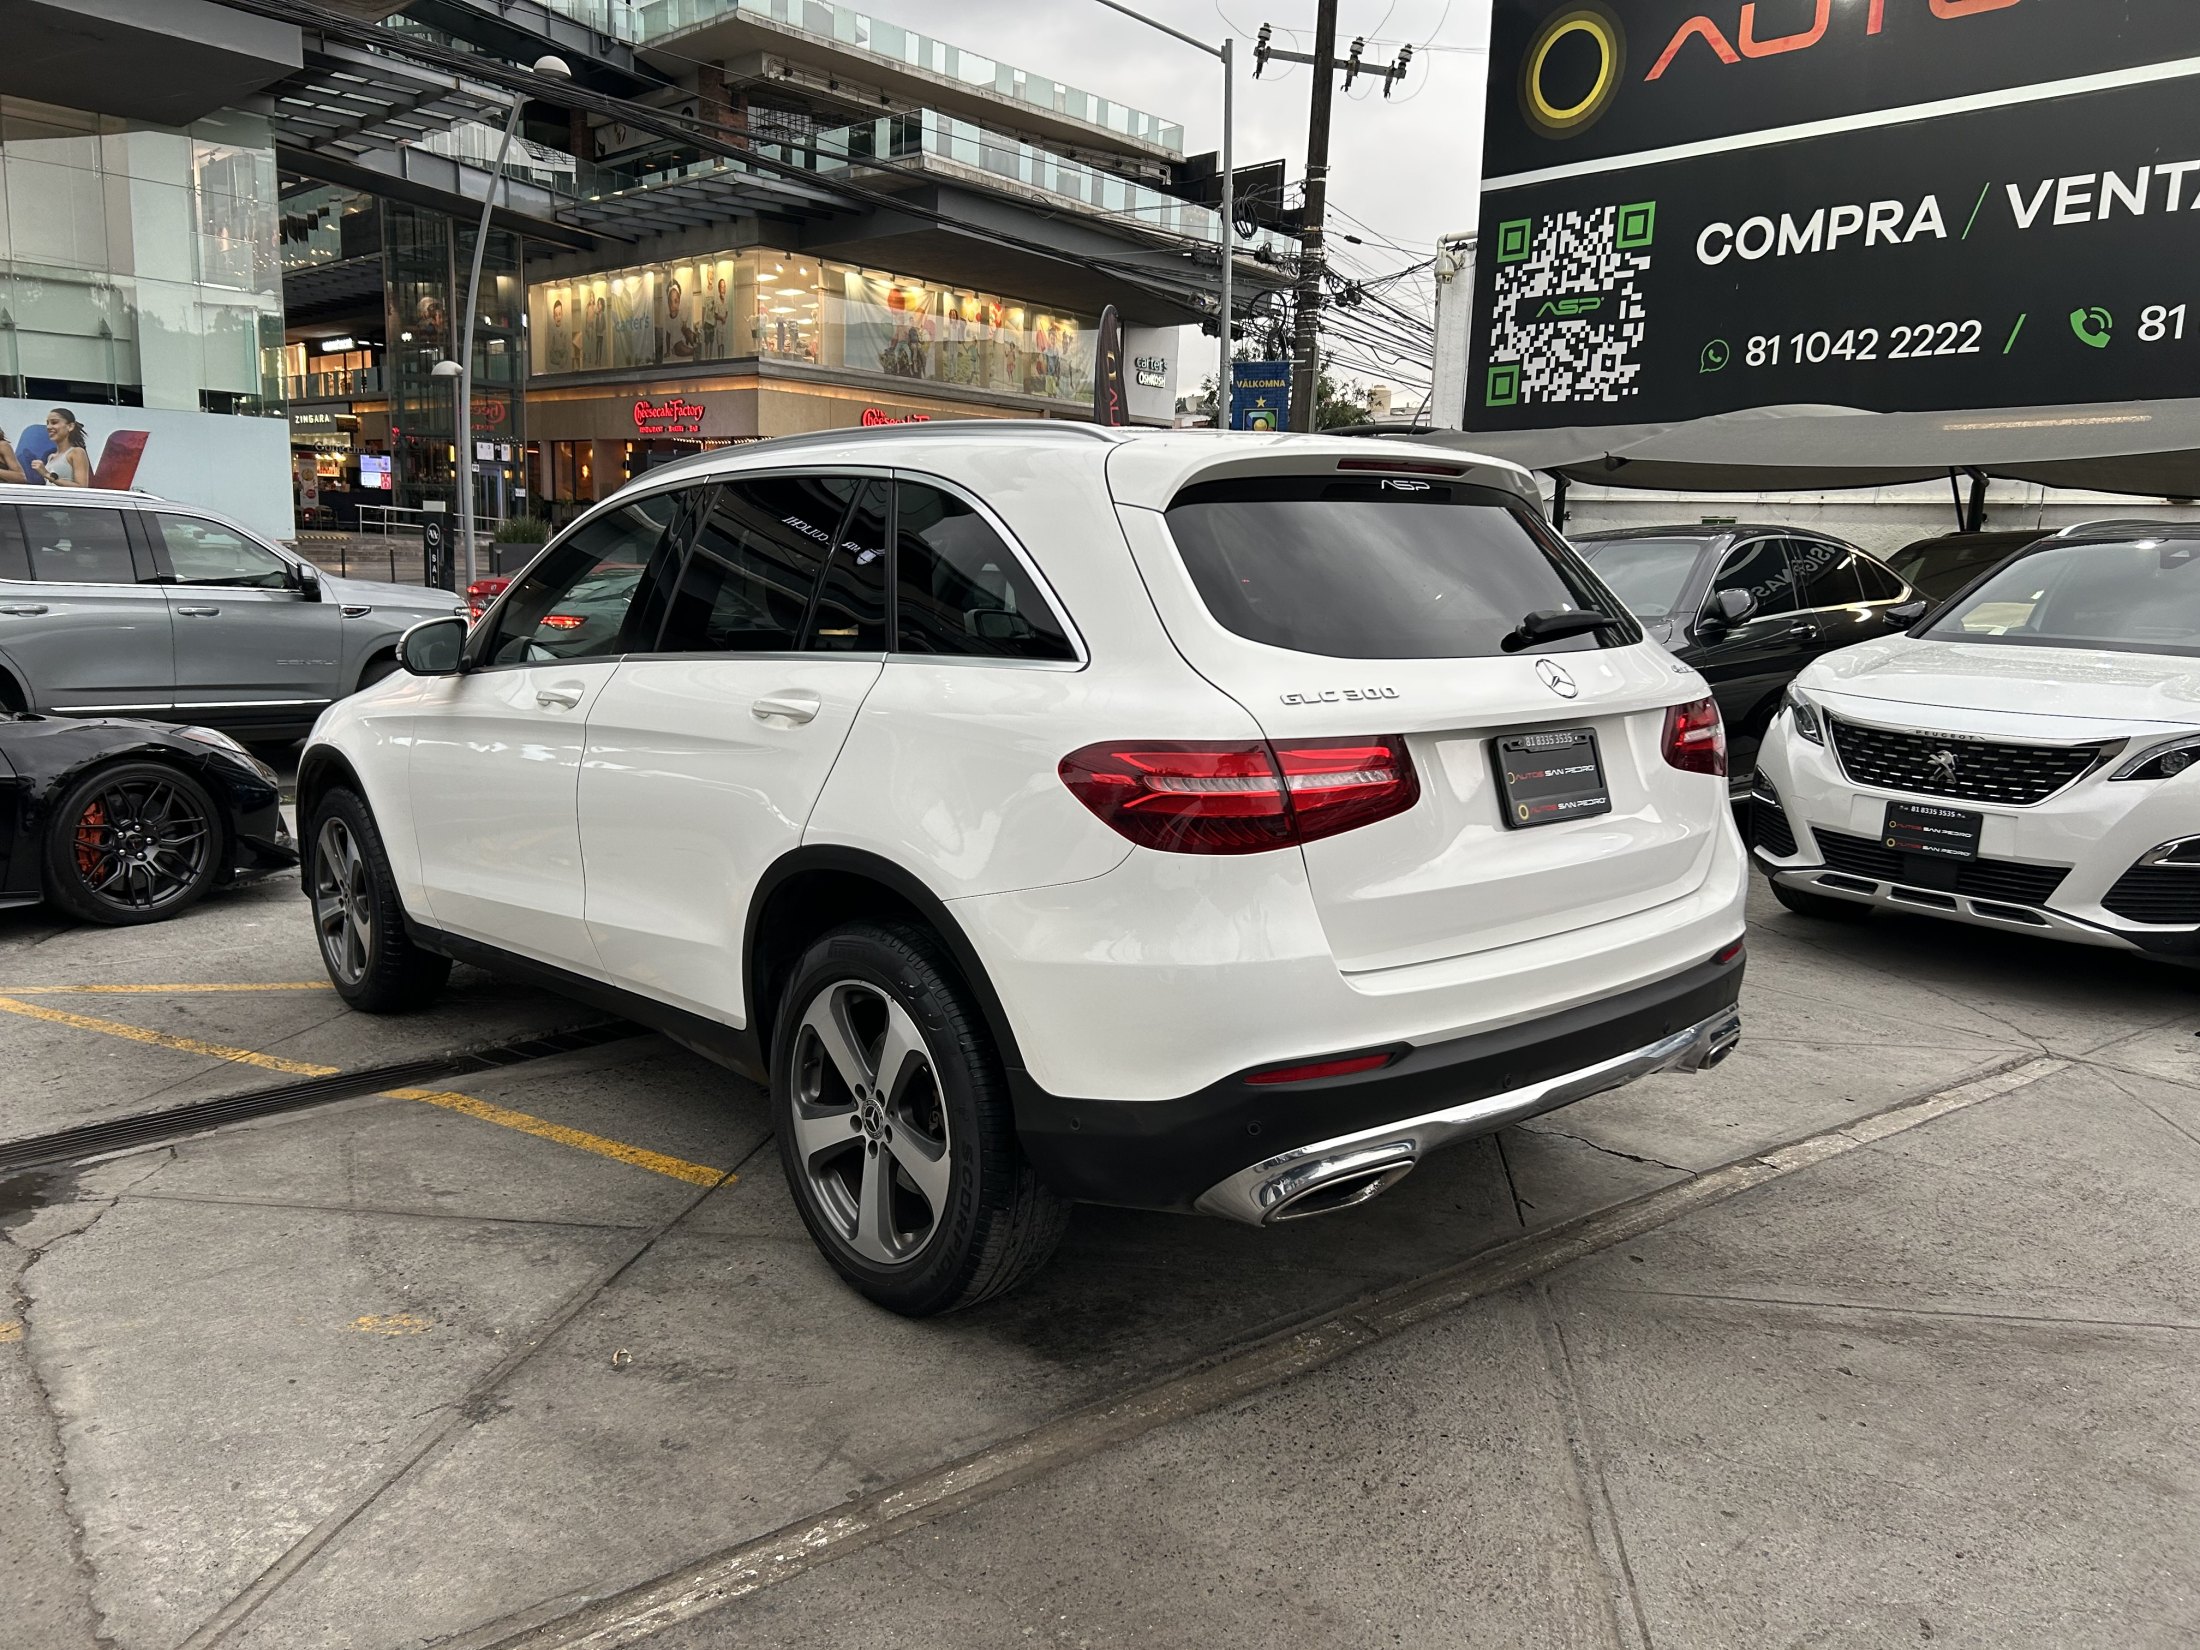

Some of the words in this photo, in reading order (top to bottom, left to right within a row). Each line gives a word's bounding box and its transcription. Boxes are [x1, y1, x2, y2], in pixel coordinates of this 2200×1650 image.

[1696, 195, 1948, 266] COMPRA
[2005, 159, 2200, 229] VENT
[1745, 335, 1781, 367] 81
[1789, 328, 1879, 364] 1042
[1888, 319, 1983, 359] 2222
[2137, 304, 2188, 342] 81
[1135, 356, 1168, 373] carter's
[295, 414, 331, 424] ZINGARA
[634, 401, 674, 426] Cheesecake
[670, 399, 704, 421] Factory
[1280, 690, 1340, 705] GLC
[1342, 686, 1400, 701] 300
[1526, 737, 1535, 747] 81
[1536, 735, 1554, 746] 8335
[1555, 733, 1573, 744] 3535
[1915, 729, 1974, 740] PEUGEOT
[1515, 770, 1544, 780] AUTOS
[1545, 768, 1564, 777] SAN
[1565, 764, 1595, 774] PEDRO
[1558, 801, 1577, 810] SAN
[1920, 807, 1938, 815] 8335
[1938, 809, 1956, 818] 3535
[1923, 826, 1941, 834] SAN
[929, 1139, 974, 1283] SCORPION
